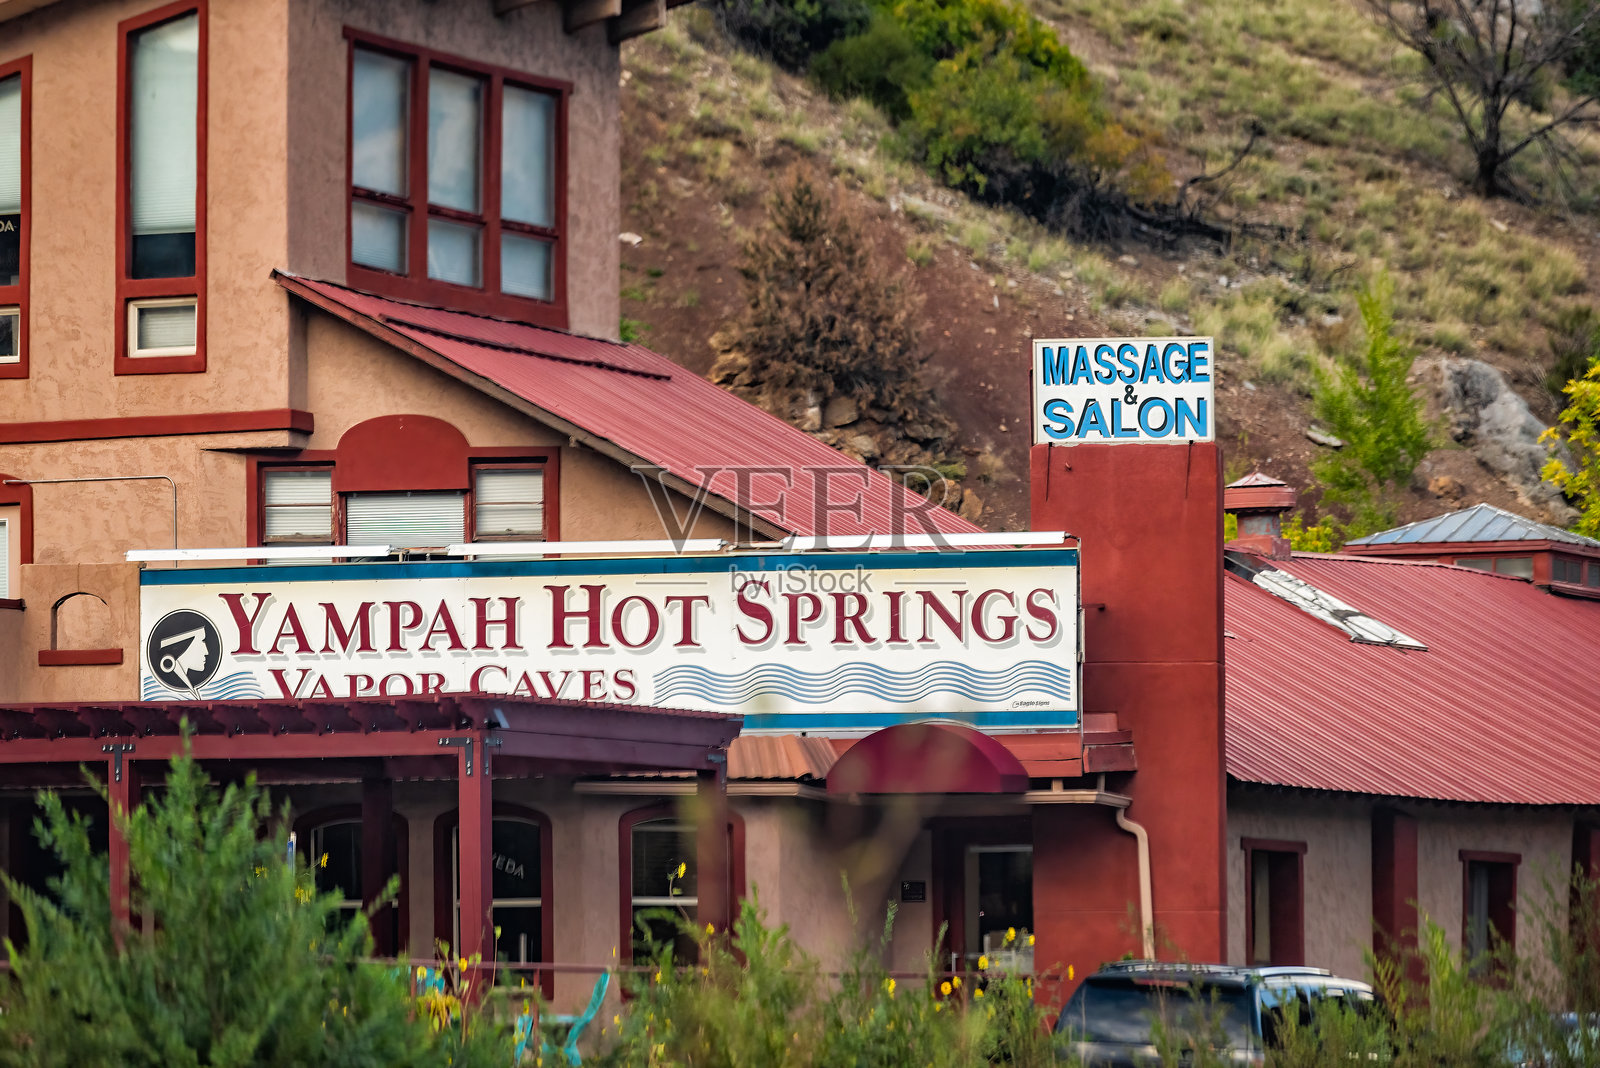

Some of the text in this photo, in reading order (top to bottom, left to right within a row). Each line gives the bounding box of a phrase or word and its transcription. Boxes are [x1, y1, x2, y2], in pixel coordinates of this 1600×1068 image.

[1042, 342, 1210, 386] MASSAGE
[1123, 384, 1138, 405] &
[1043, 396, 1208, 439] SALON
[218, 579, 1058, 656] YAMPAH HOT SPRINGS
[267, 665, 637, 701] VAPOR CAVES
